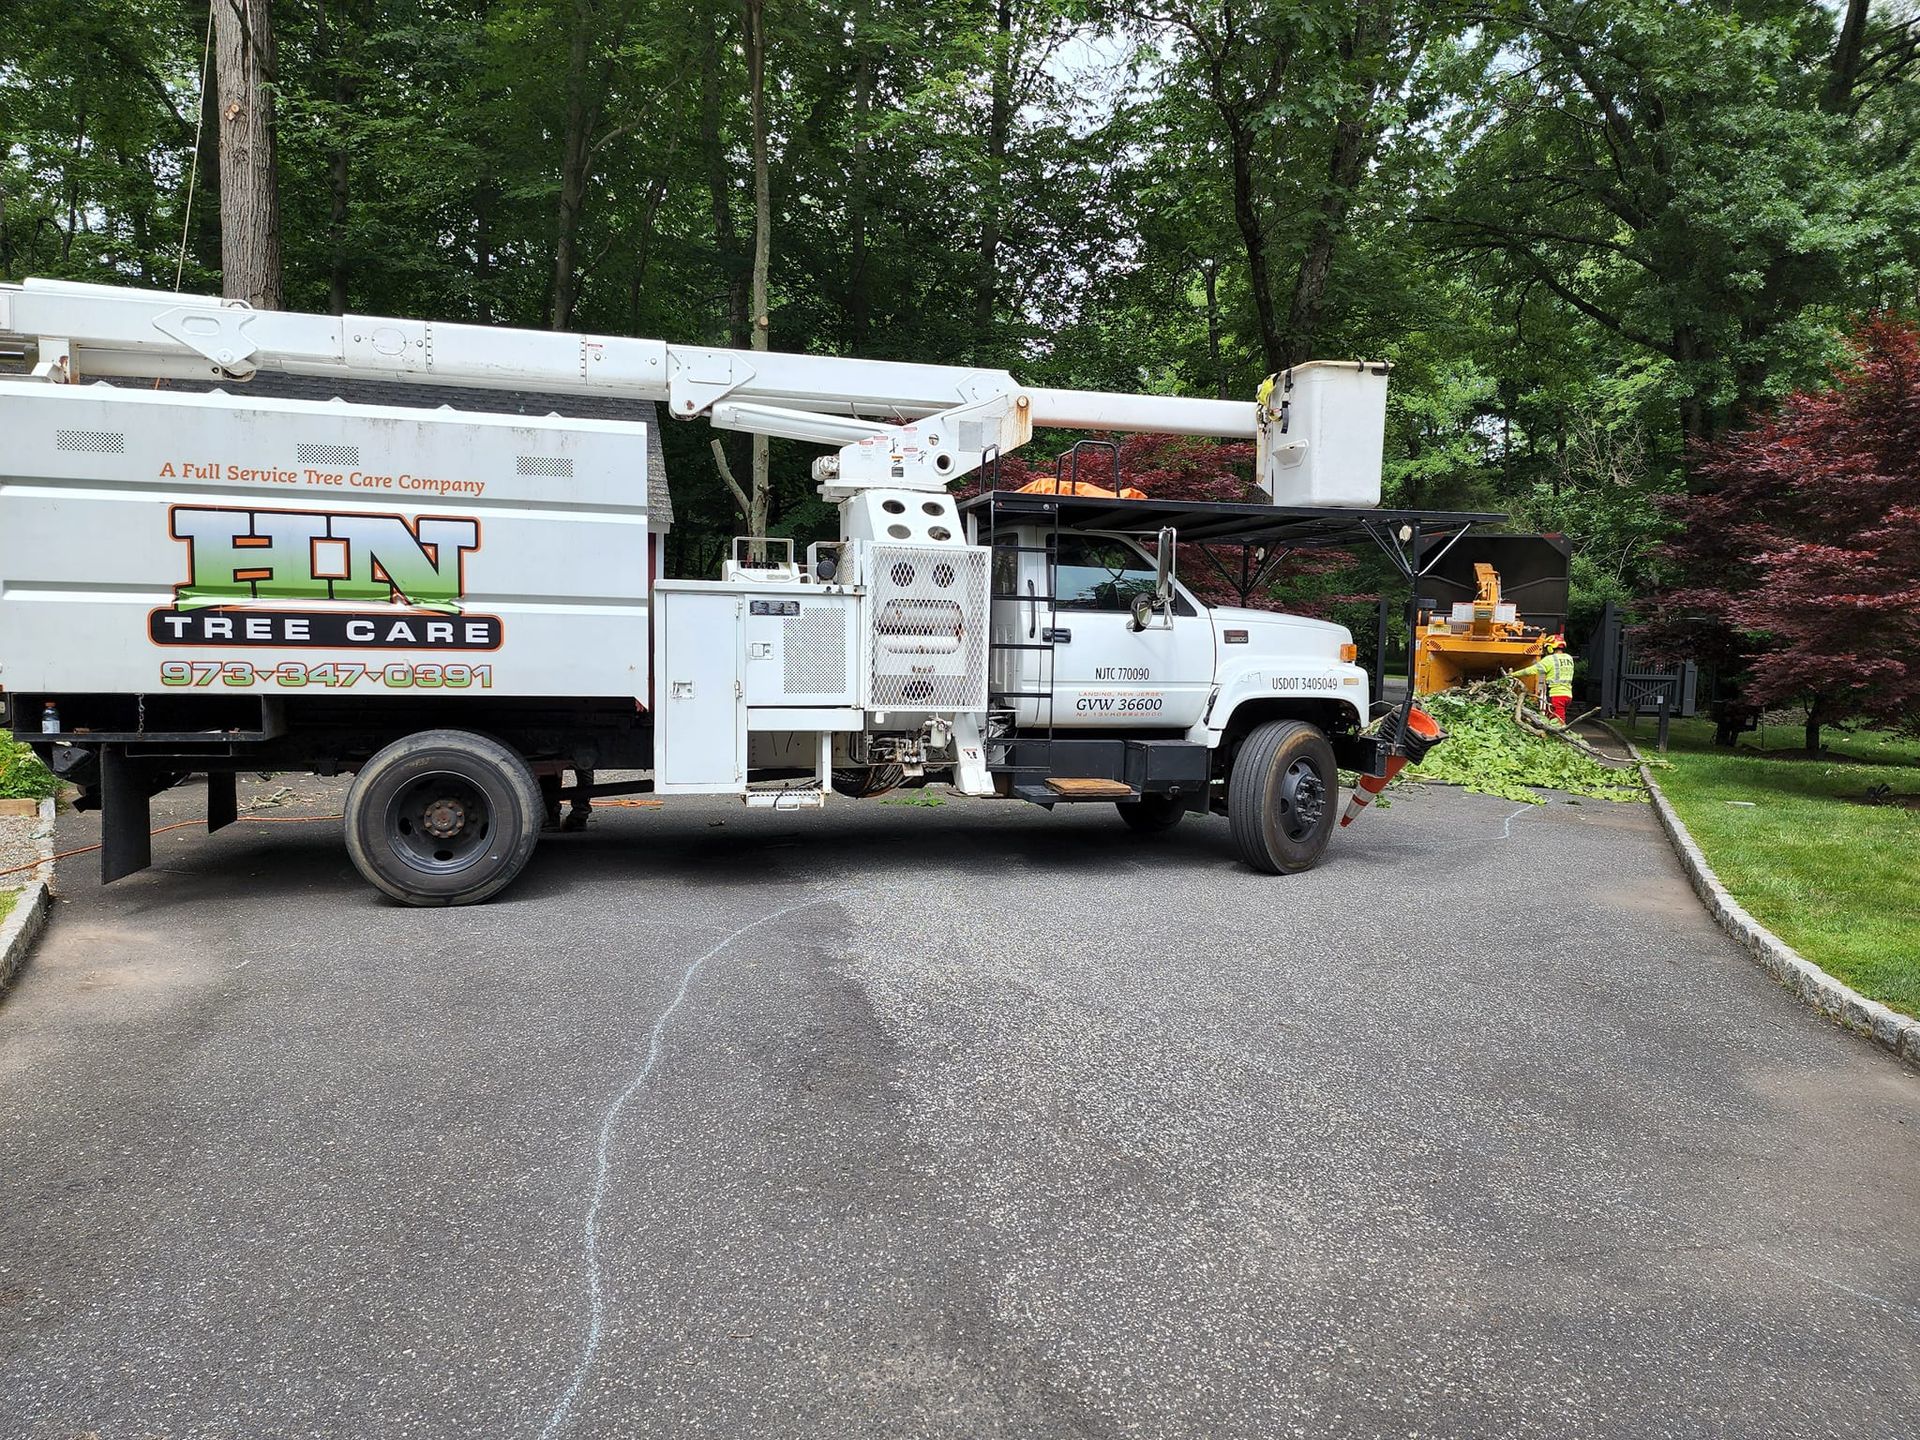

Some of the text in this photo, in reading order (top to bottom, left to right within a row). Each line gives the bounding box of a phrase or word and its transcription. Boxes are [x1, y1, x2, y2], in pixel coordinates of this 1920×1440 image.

[159, 462, 485, 497] A Full Service Tree Care Company
[170, 504, 481, 614] HN
[164, 616, 490, 644] TREE CARE
[1095, 668, 1150, 680] NJTC 770090
[1272, 678, 1338, 690] USDOT 3405049
[1076, 698, 1162, 710] GVW 36600
